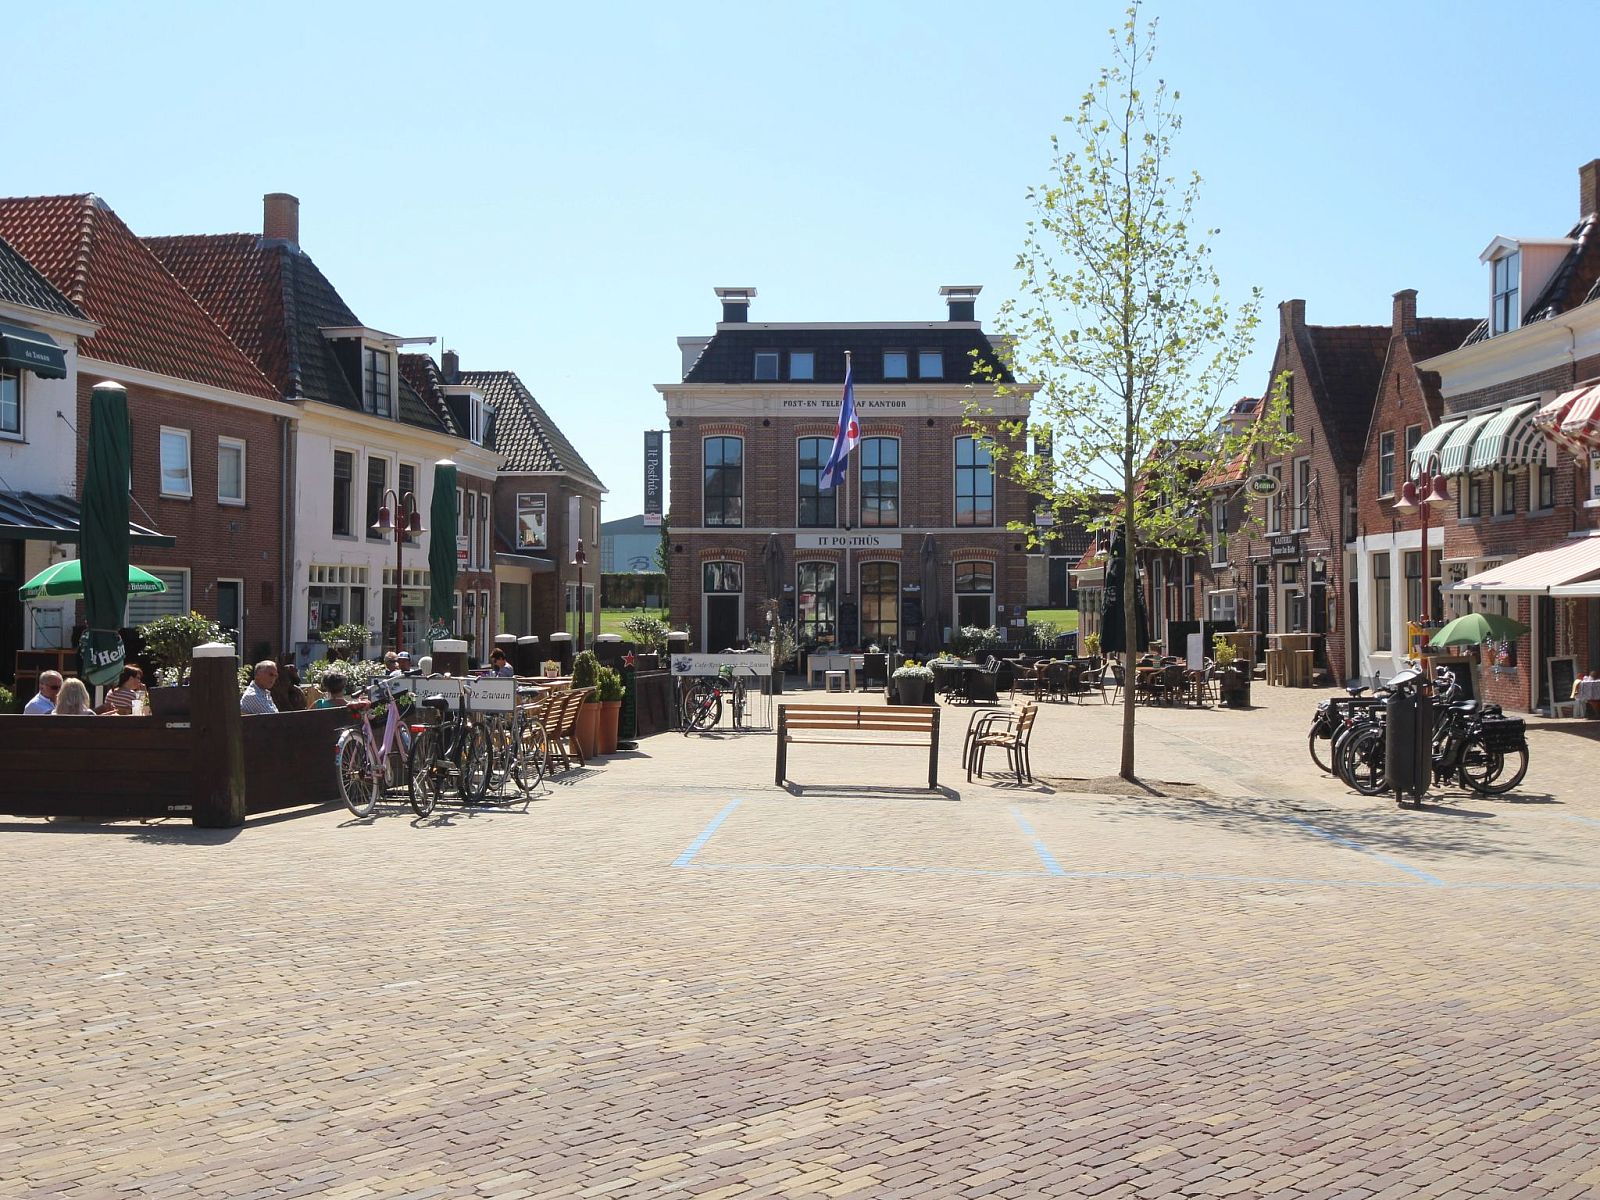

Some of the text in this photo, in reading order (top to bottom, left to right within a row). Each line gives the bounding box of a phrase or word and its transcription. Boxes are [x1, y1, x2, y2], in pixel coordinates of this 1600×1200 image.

[868, 400, 906, 408] KANTOOR
[819, 537, 828, 545] IT
[470, 691, 479, 699] De
[480, 691, 511, 699] Zwaan
